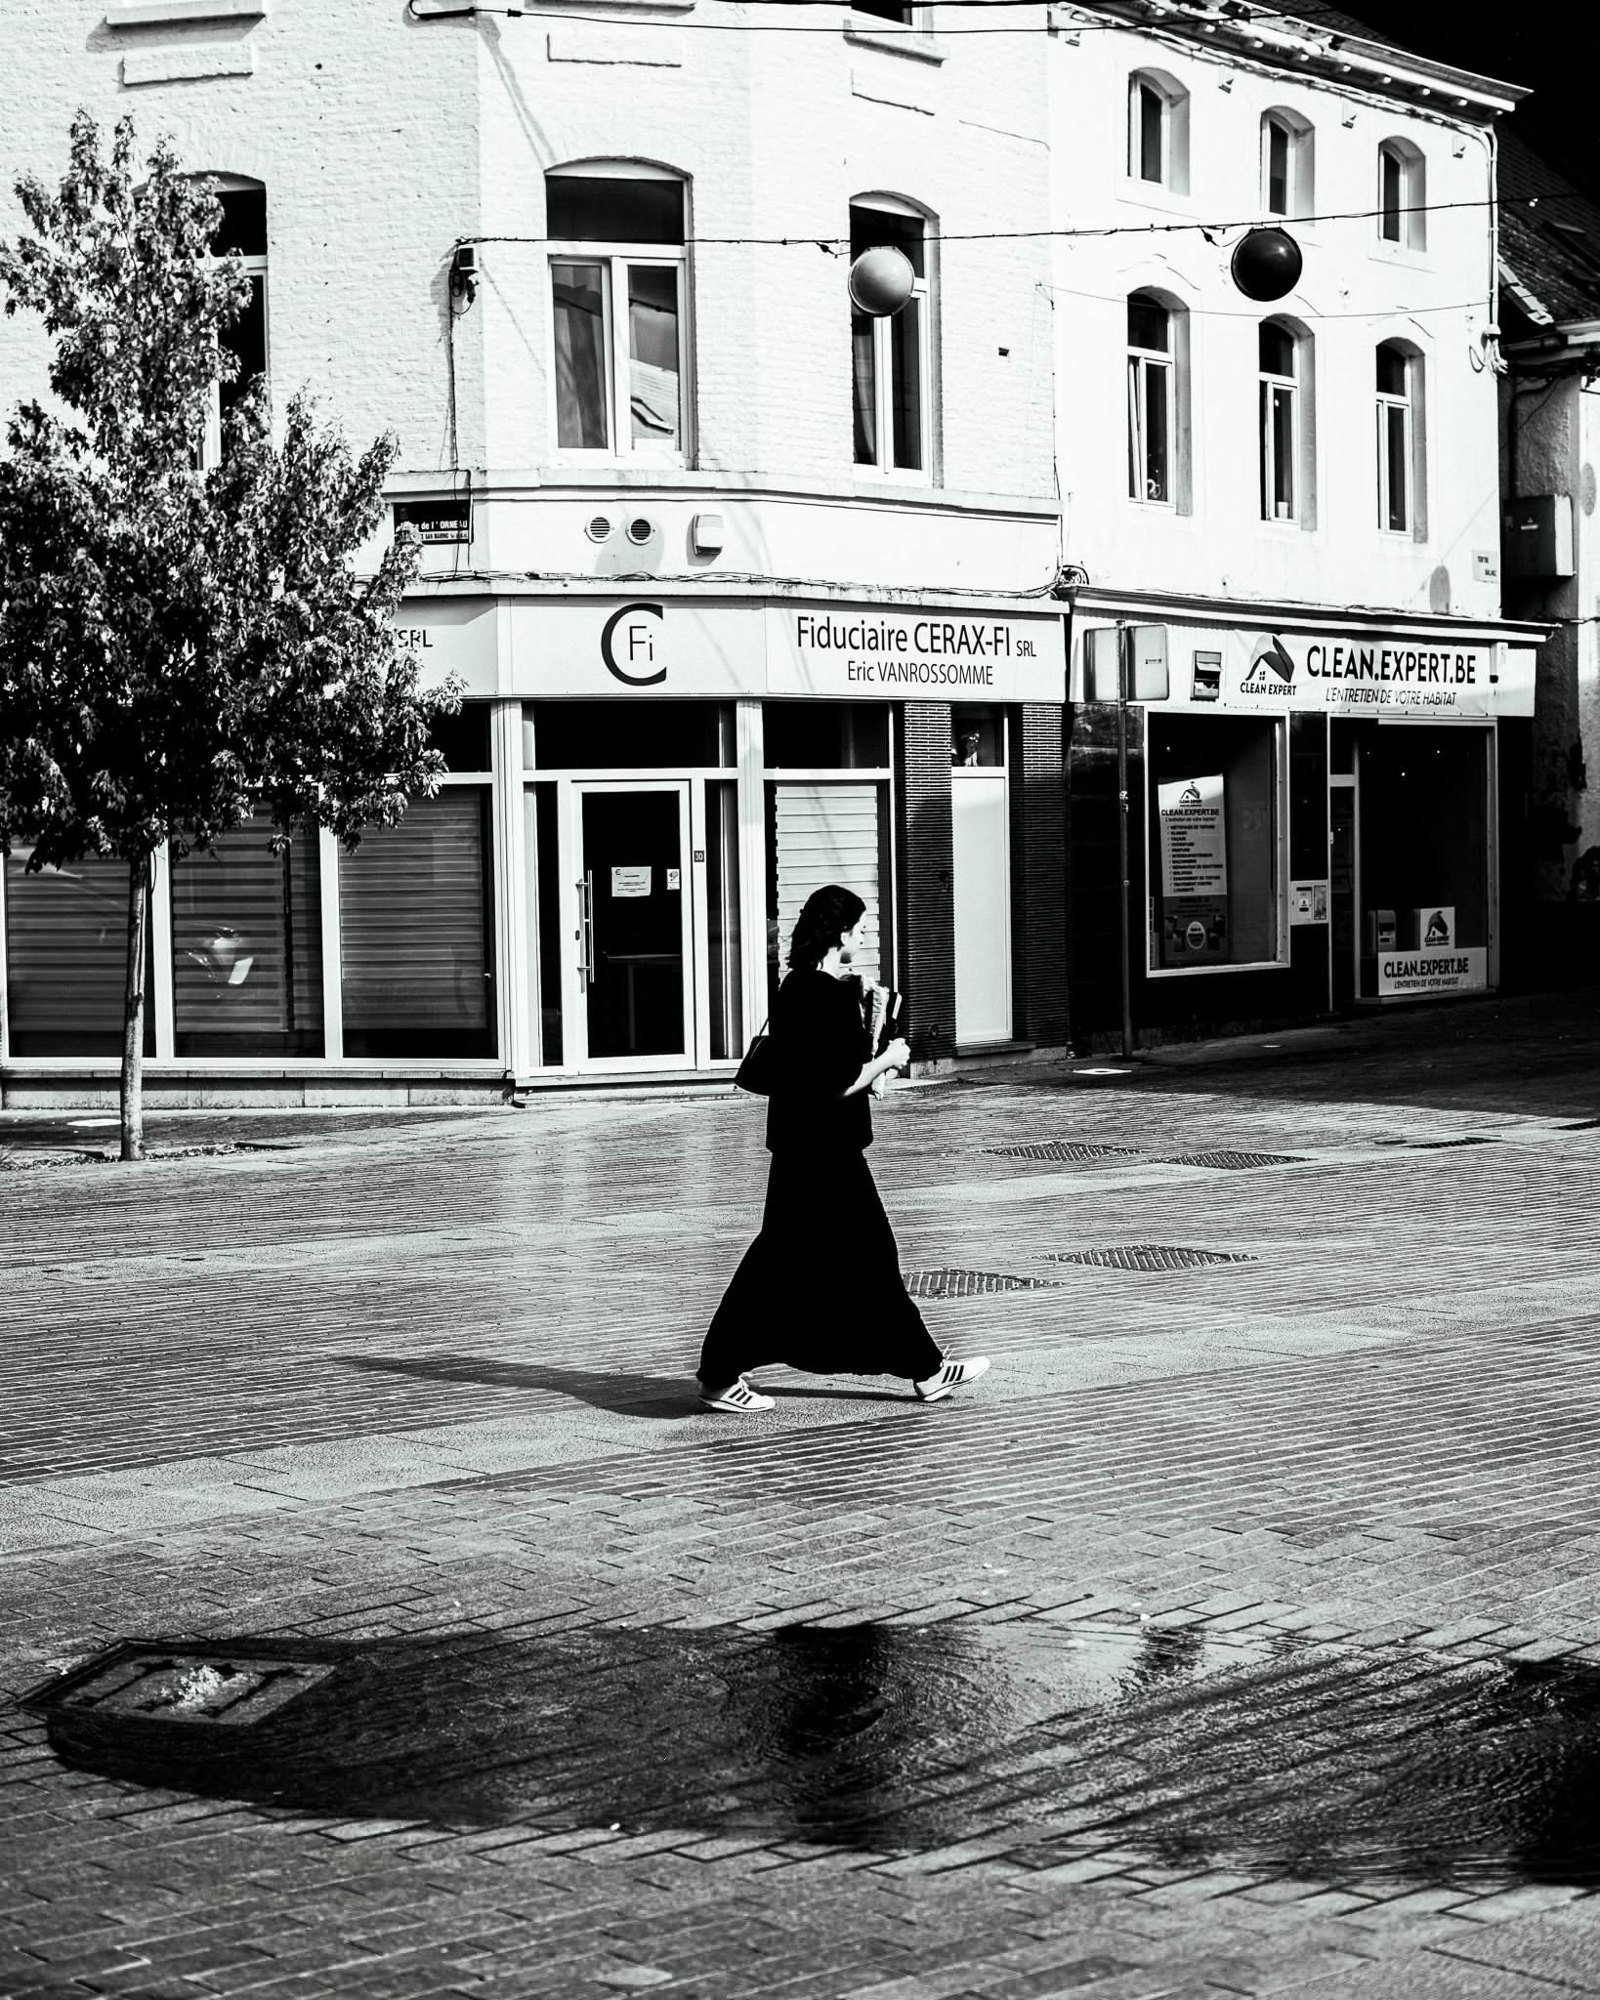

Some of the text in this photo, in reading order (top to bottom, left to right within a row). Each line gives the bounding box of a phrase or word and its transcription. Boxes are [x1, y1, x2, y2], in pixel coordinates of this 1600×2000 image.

[797, 616, 1037, 657] Fiduciaire CERAX-FI SRL
[848, 660, 993, 685] Eric VANROSSOMME
[1307, 644, 1476, 685] CLEAN.EXPERT.BE
[1240, 682, 1297, 696] CLEAN EXPERT
[1325, 687, 1457, 706] L'ENTRETIEN DE VOTRE HABITAT
[1384, 957, 1469, 979] CLEAN.EXPERT.BE
